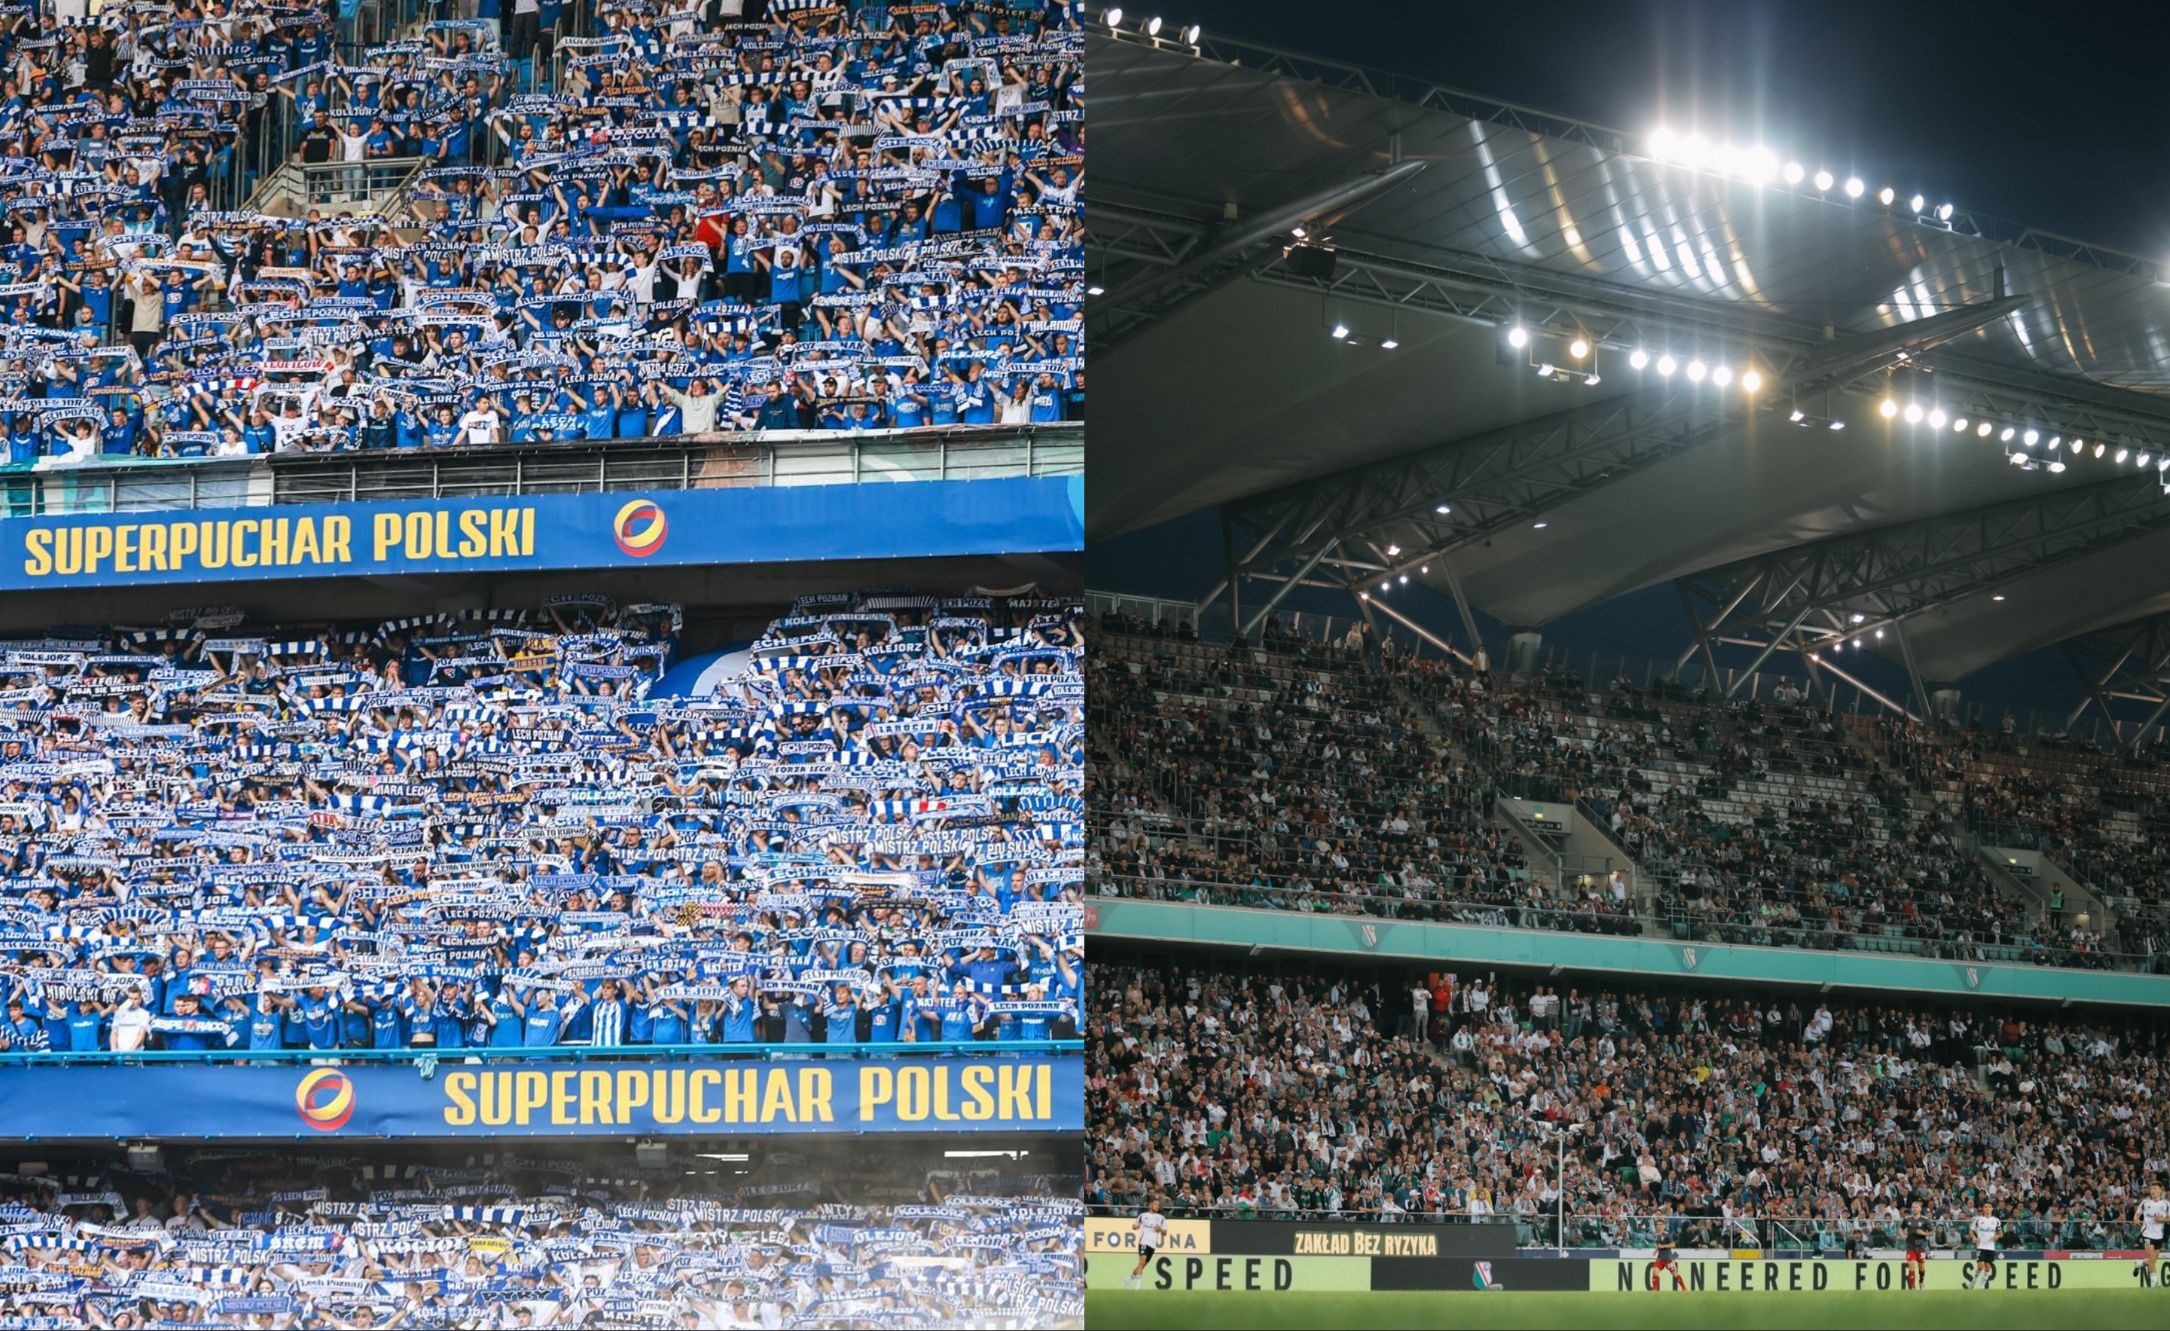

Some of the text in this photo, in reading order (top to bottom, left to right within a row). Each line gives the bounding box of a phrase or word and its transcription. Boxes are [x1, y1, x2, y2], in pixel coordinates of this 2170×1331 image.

[1053, 110, 1078, 121] STRZ
[842, 203, 863, 212] LECH
[566, 374, 585, 383] LECH
[24, 508, 535, 575] SUPERPUCHAR POLSKI
[864, 643, 923, 656] KOLEJORZ
[18, 653, 70, 661] KOLEJORZ
[512, 728, 531, 741] LECH
[1001, 730, 1059, 747] LECH
[452, 762, 473, 771] LECH
[988, 786, 1047, 797] KOLEJORZ
[828, 831, 871, 844] MISTRZ
[874, 840, 918, 855] MISTRZ
[445, 910, 468, 918] LECH
[441, 937, 462, 945] LECH
[994, 1002, 1015, 1011] LECH
[443, 1064, 1052, 1127] SUPERPUCHAR POLSKI
[314, 1202, 355, 1215] MISTRZ
[618, 1207, 639, 1218] LECH
[696, 1209, 739, 1221] MISTRZ
[284, 1225, 305, 1234] LECH
[1094, 1231, 1196, 1249] FORUNA
[1295, 1233, 1437, 1255] ZAKŁAD BEZ RYZYKA
[188, 1249, 228, 1263] MISTRZ
[1154, 1258, 1293, 1290] SPEED
[300, 1279, 324, 1289] Lech
